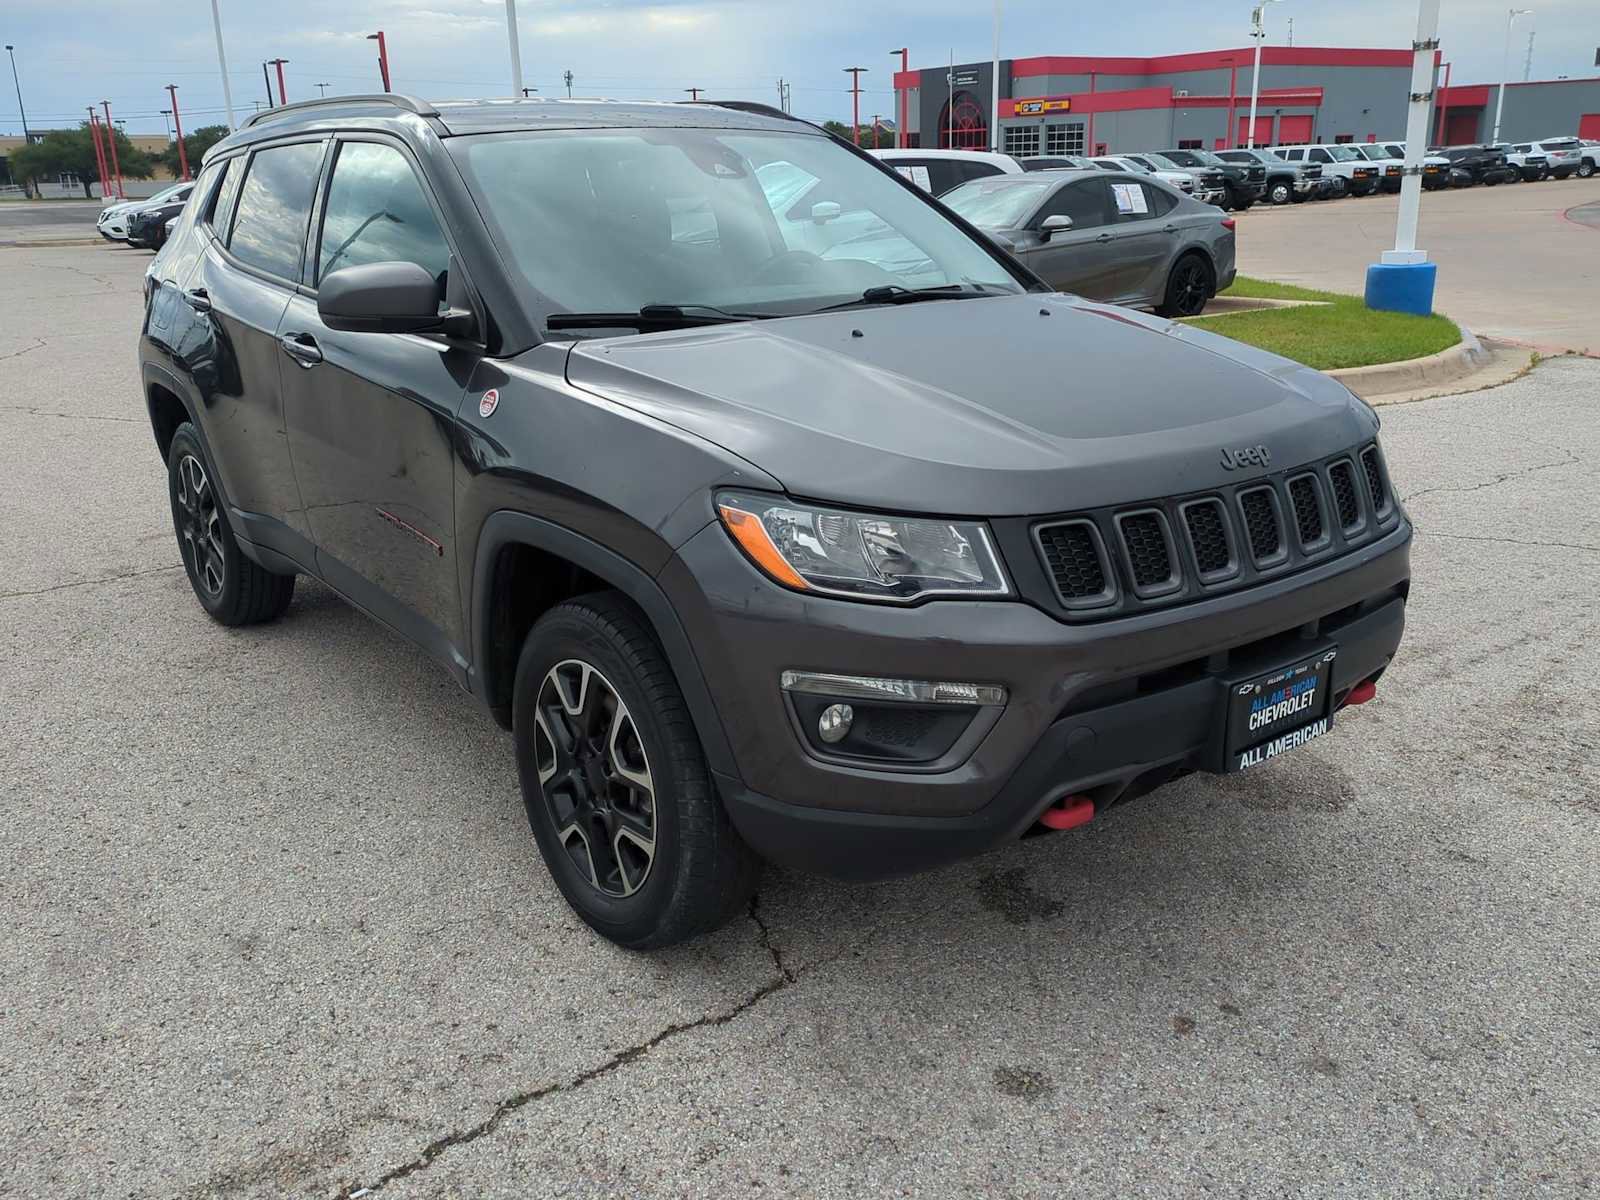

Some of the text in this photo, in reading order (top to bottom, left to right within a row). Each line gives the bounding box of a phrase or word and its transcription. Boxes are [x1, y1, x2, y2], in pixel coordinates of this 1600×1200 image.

[1220, 445, 1271, 471] Jeep
[1249, 688, 1316, 731] CHEVROLET
[1251, 696, 1269, 713] ALL
[1271, 676, 1318, 704] AMERICAN
[1240, 719, 1329, 770] ALL AMERICAN
